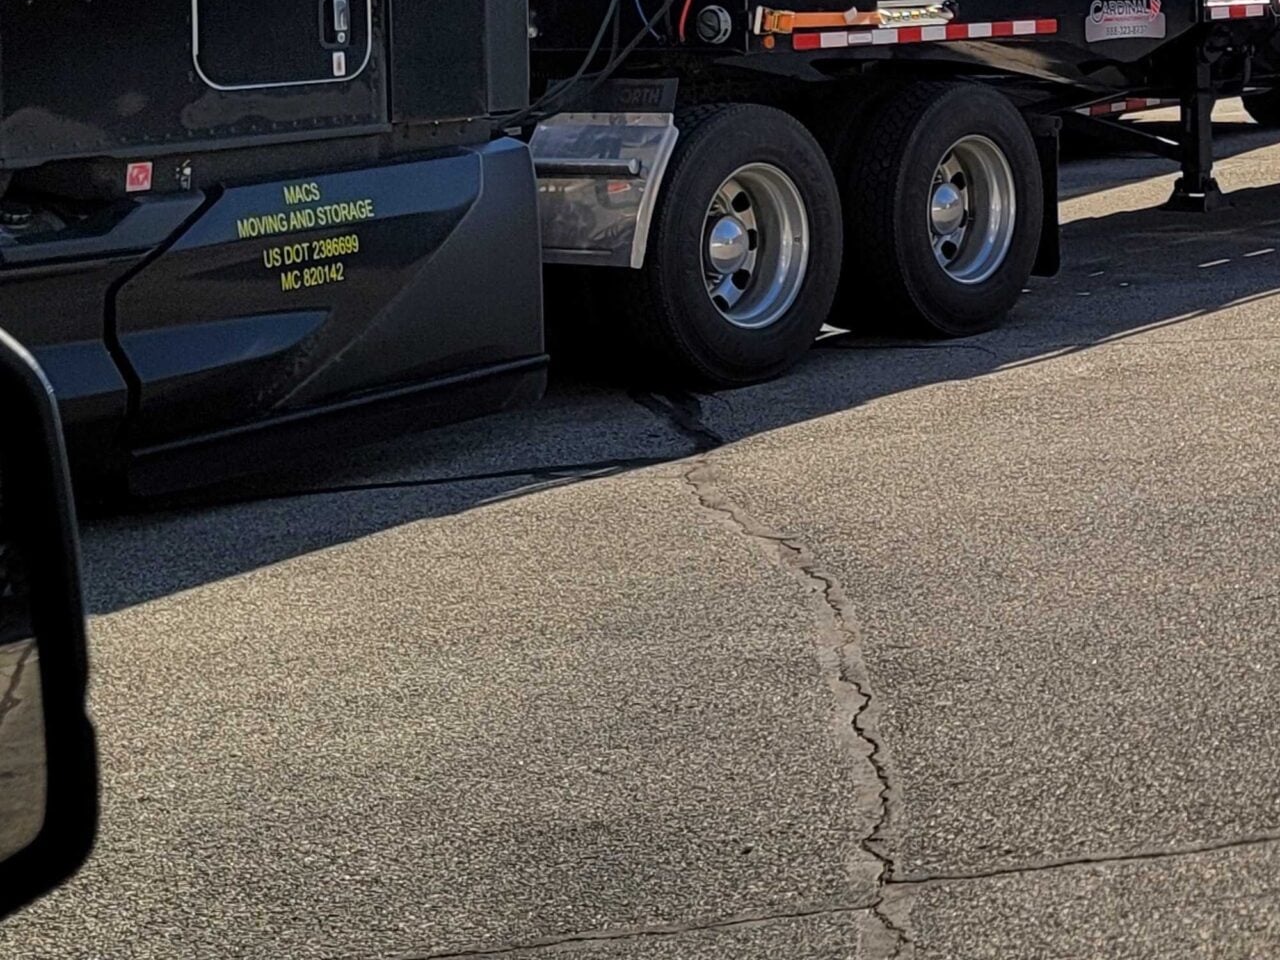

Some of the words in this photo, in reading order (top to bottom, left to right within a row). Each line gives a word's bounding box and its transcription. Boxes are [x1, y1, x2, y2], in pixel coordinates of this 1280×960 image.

[283, 182, 320, 205] MACS
[236, 213, 288, 238] MOVING
[290, 209, 316, 230] AND
[317, 199, 375, 226] STORAGE
[263, 248, 282, 269] US
[283, 243, 310, 266] DOT
[312, 234, 360, 261] 2386699
[281, 269, 302, 291] MC
[303, 262, 345, 287] 820142
